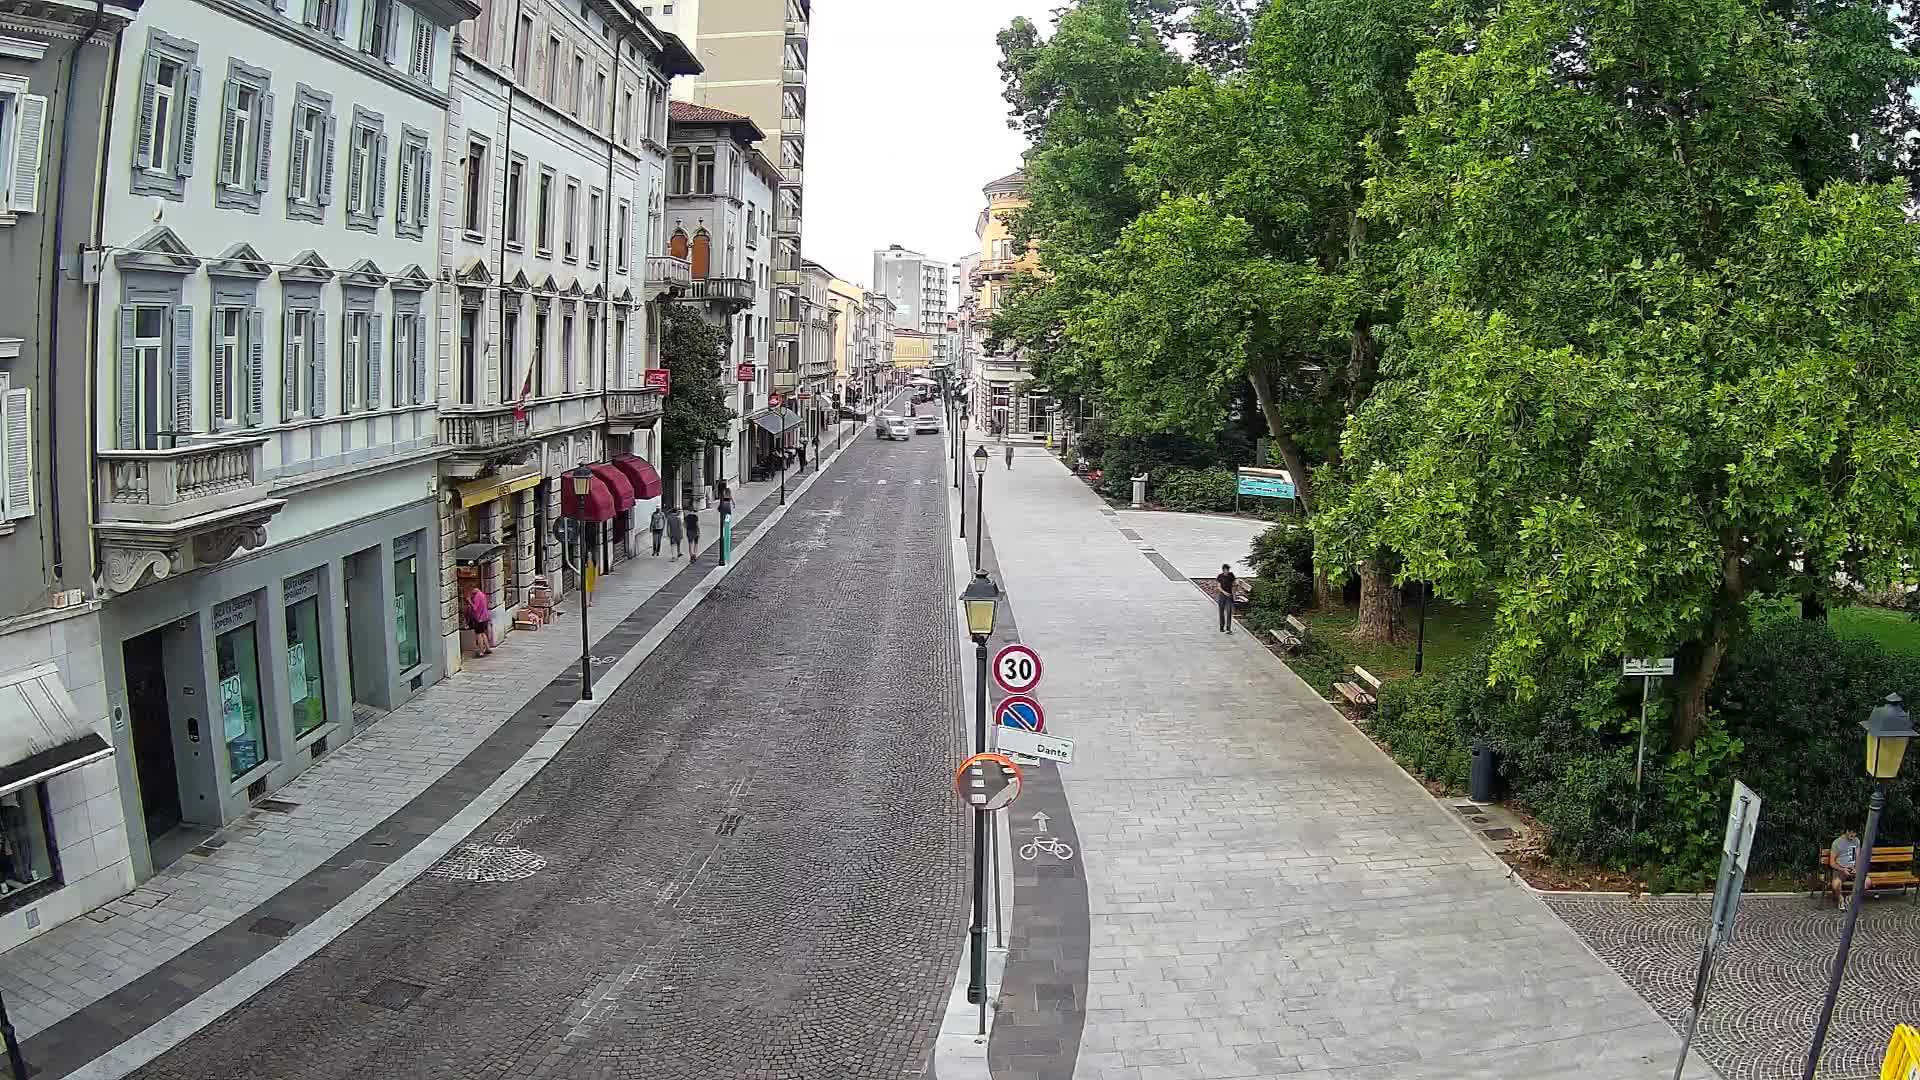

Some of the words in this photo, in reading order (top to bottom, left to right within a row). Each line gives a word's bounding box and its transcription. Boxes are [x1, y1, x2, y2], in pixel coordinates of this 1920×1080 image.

[1005, 658, 1032, 680] 30
[221, 678, 239, 702] 130
[1037, 744, 1067, 757] Dante
